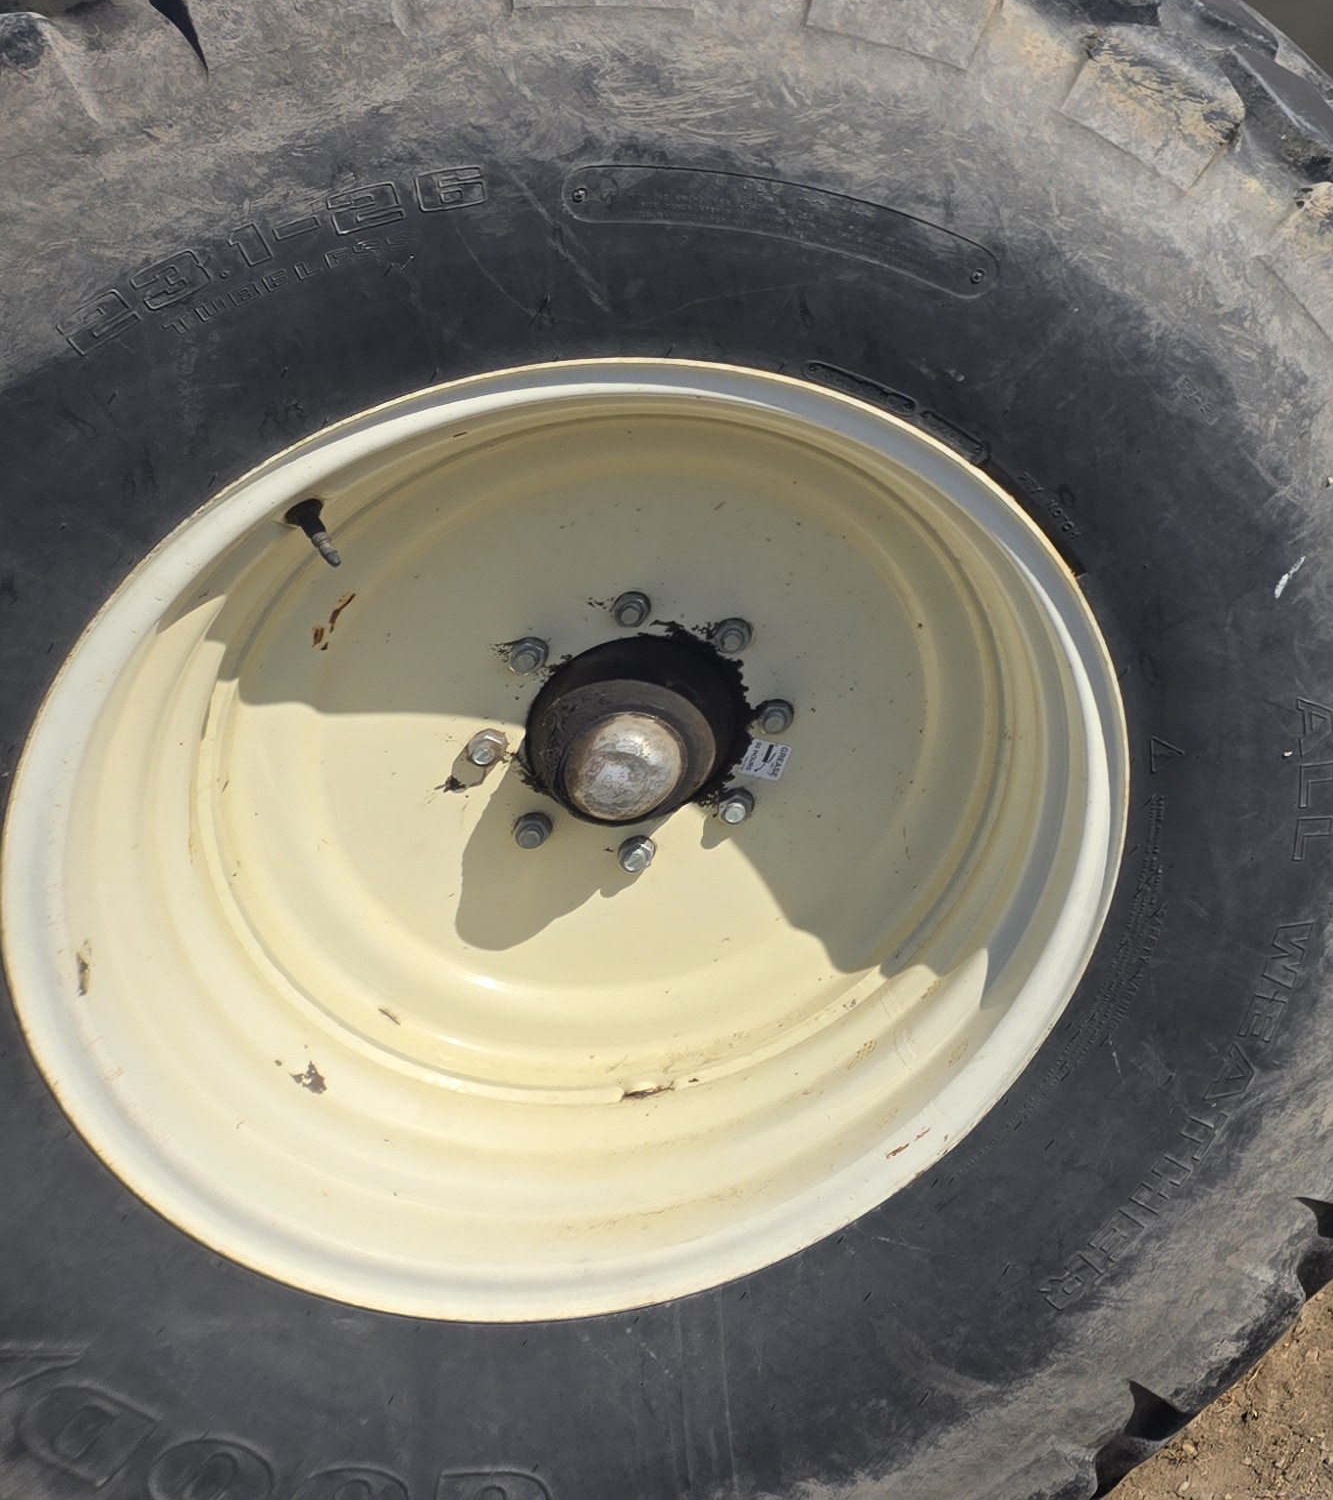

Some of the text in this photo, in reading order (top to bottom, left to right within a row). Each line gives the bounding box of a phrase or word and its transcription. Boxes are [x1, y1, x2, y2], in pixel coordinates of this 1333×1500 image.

[162, 234, 418, 336] TUBELESS
[771, 746, 789, 778] GREASE
[1036, 920, 1315, 1312] WEATHER
